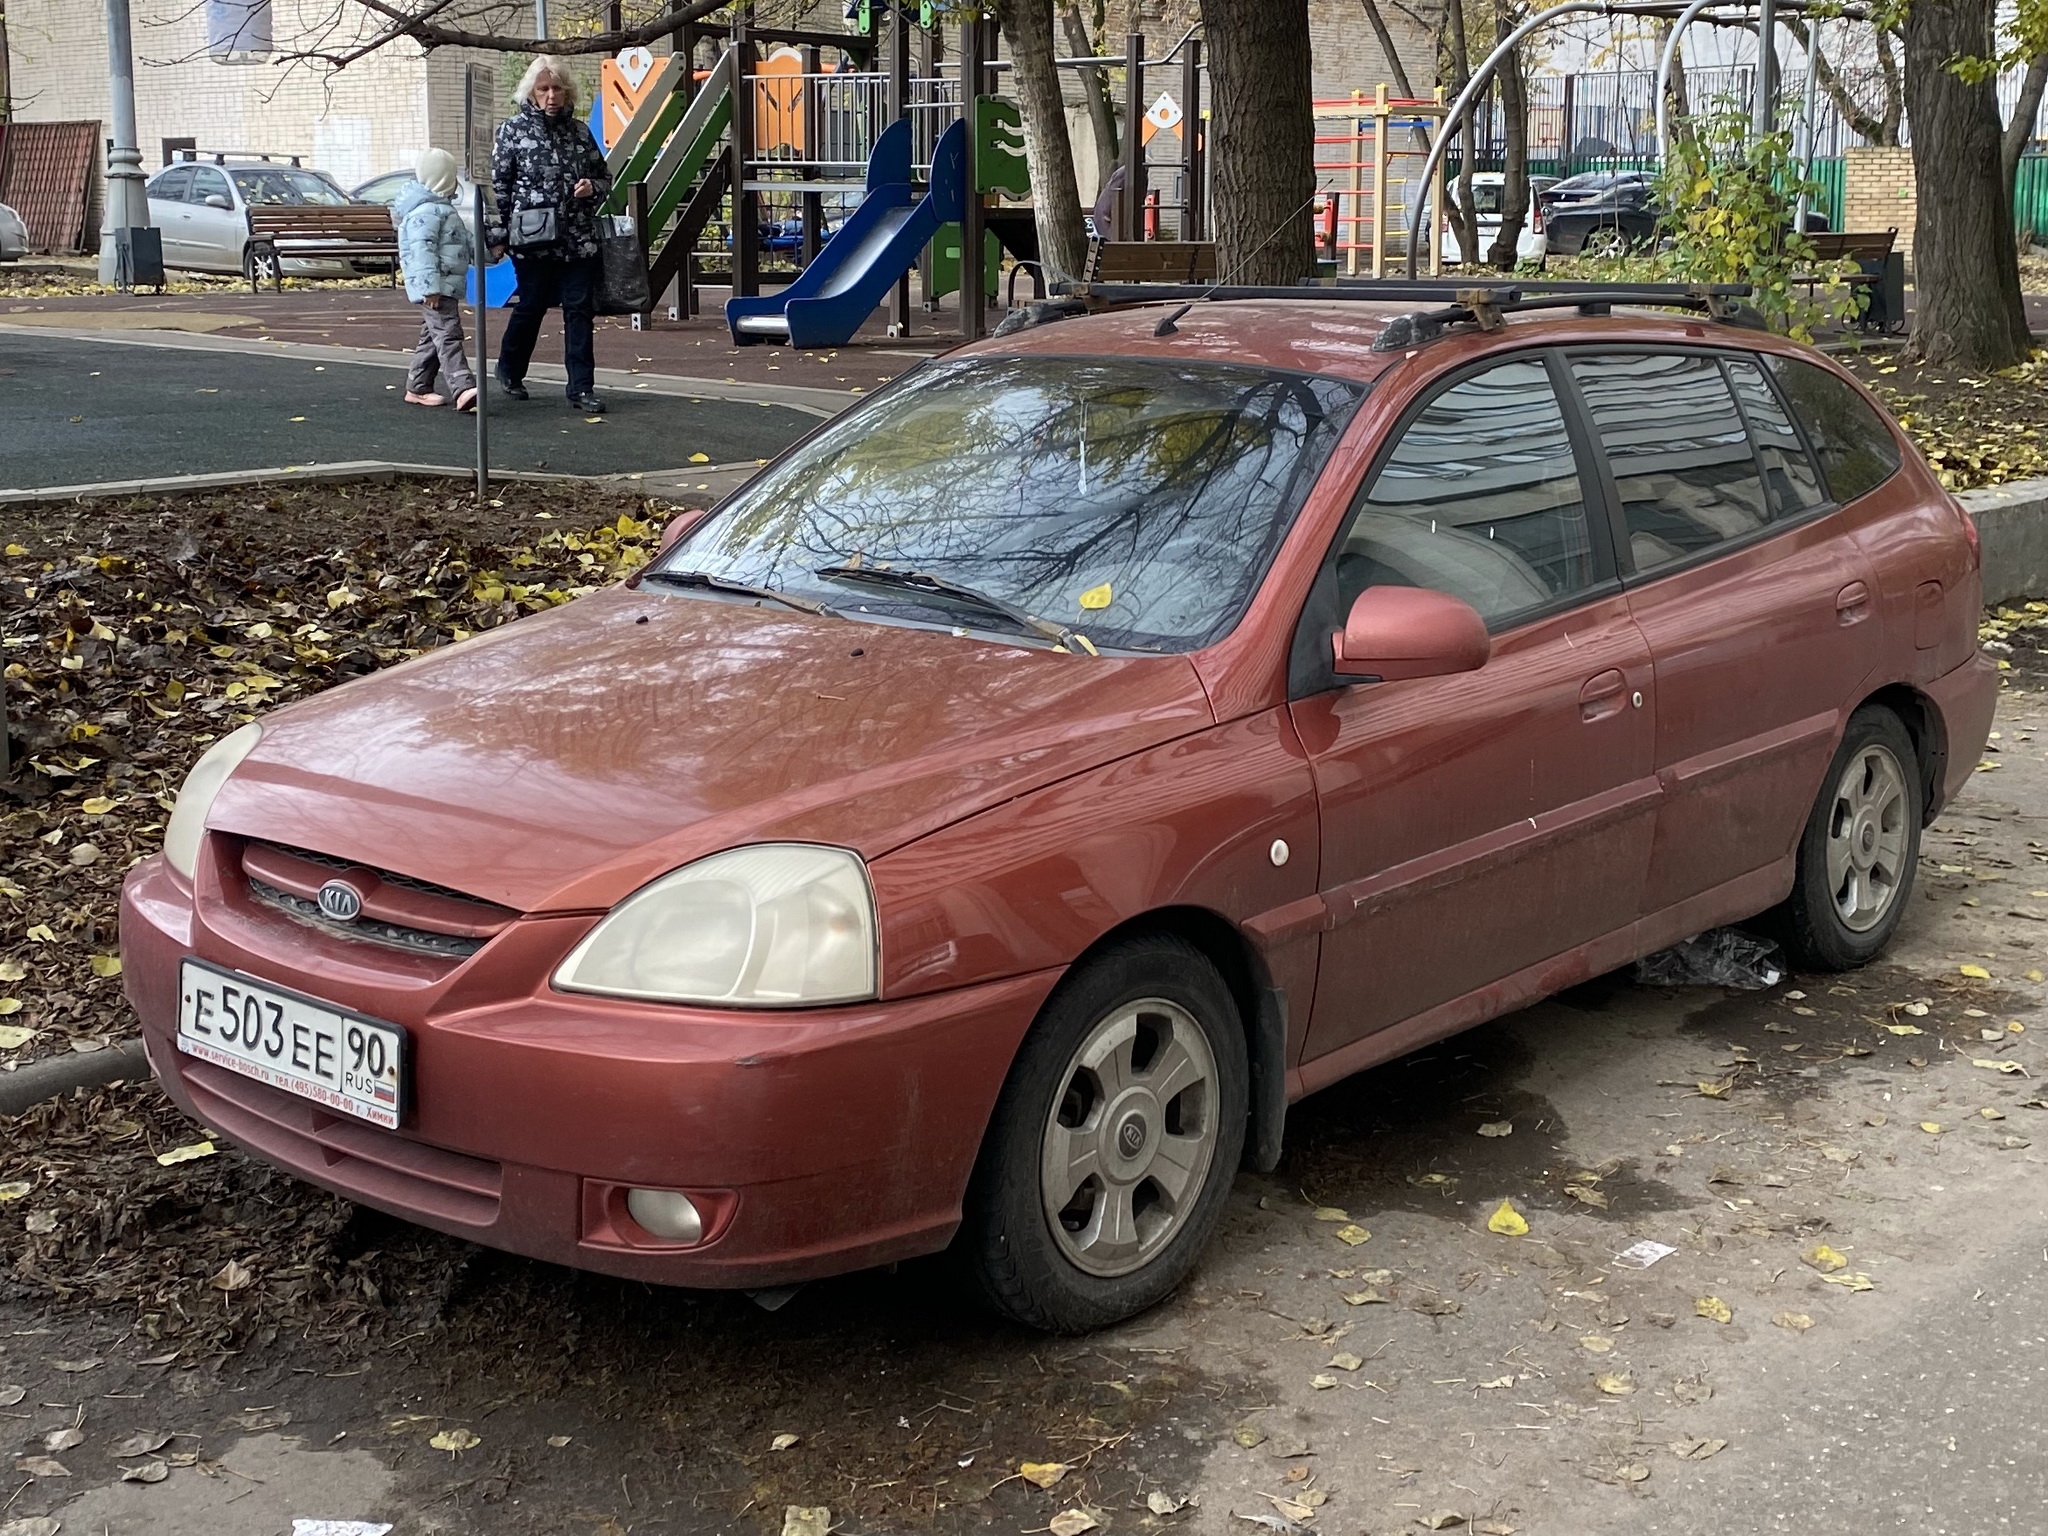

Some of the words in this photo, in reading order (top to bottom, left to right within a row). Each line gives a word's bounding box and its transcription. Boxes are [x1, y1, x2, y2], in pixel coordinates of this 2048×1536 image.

[324, 889, 352, 914] KIA
[348, 1027, 386, 1078] 90
[192, 1043, 269, 1080] www.service-bosch.ru
[366, 1106, 394, 1125] Химки
[345, 1072, 373, 1095] RUS
